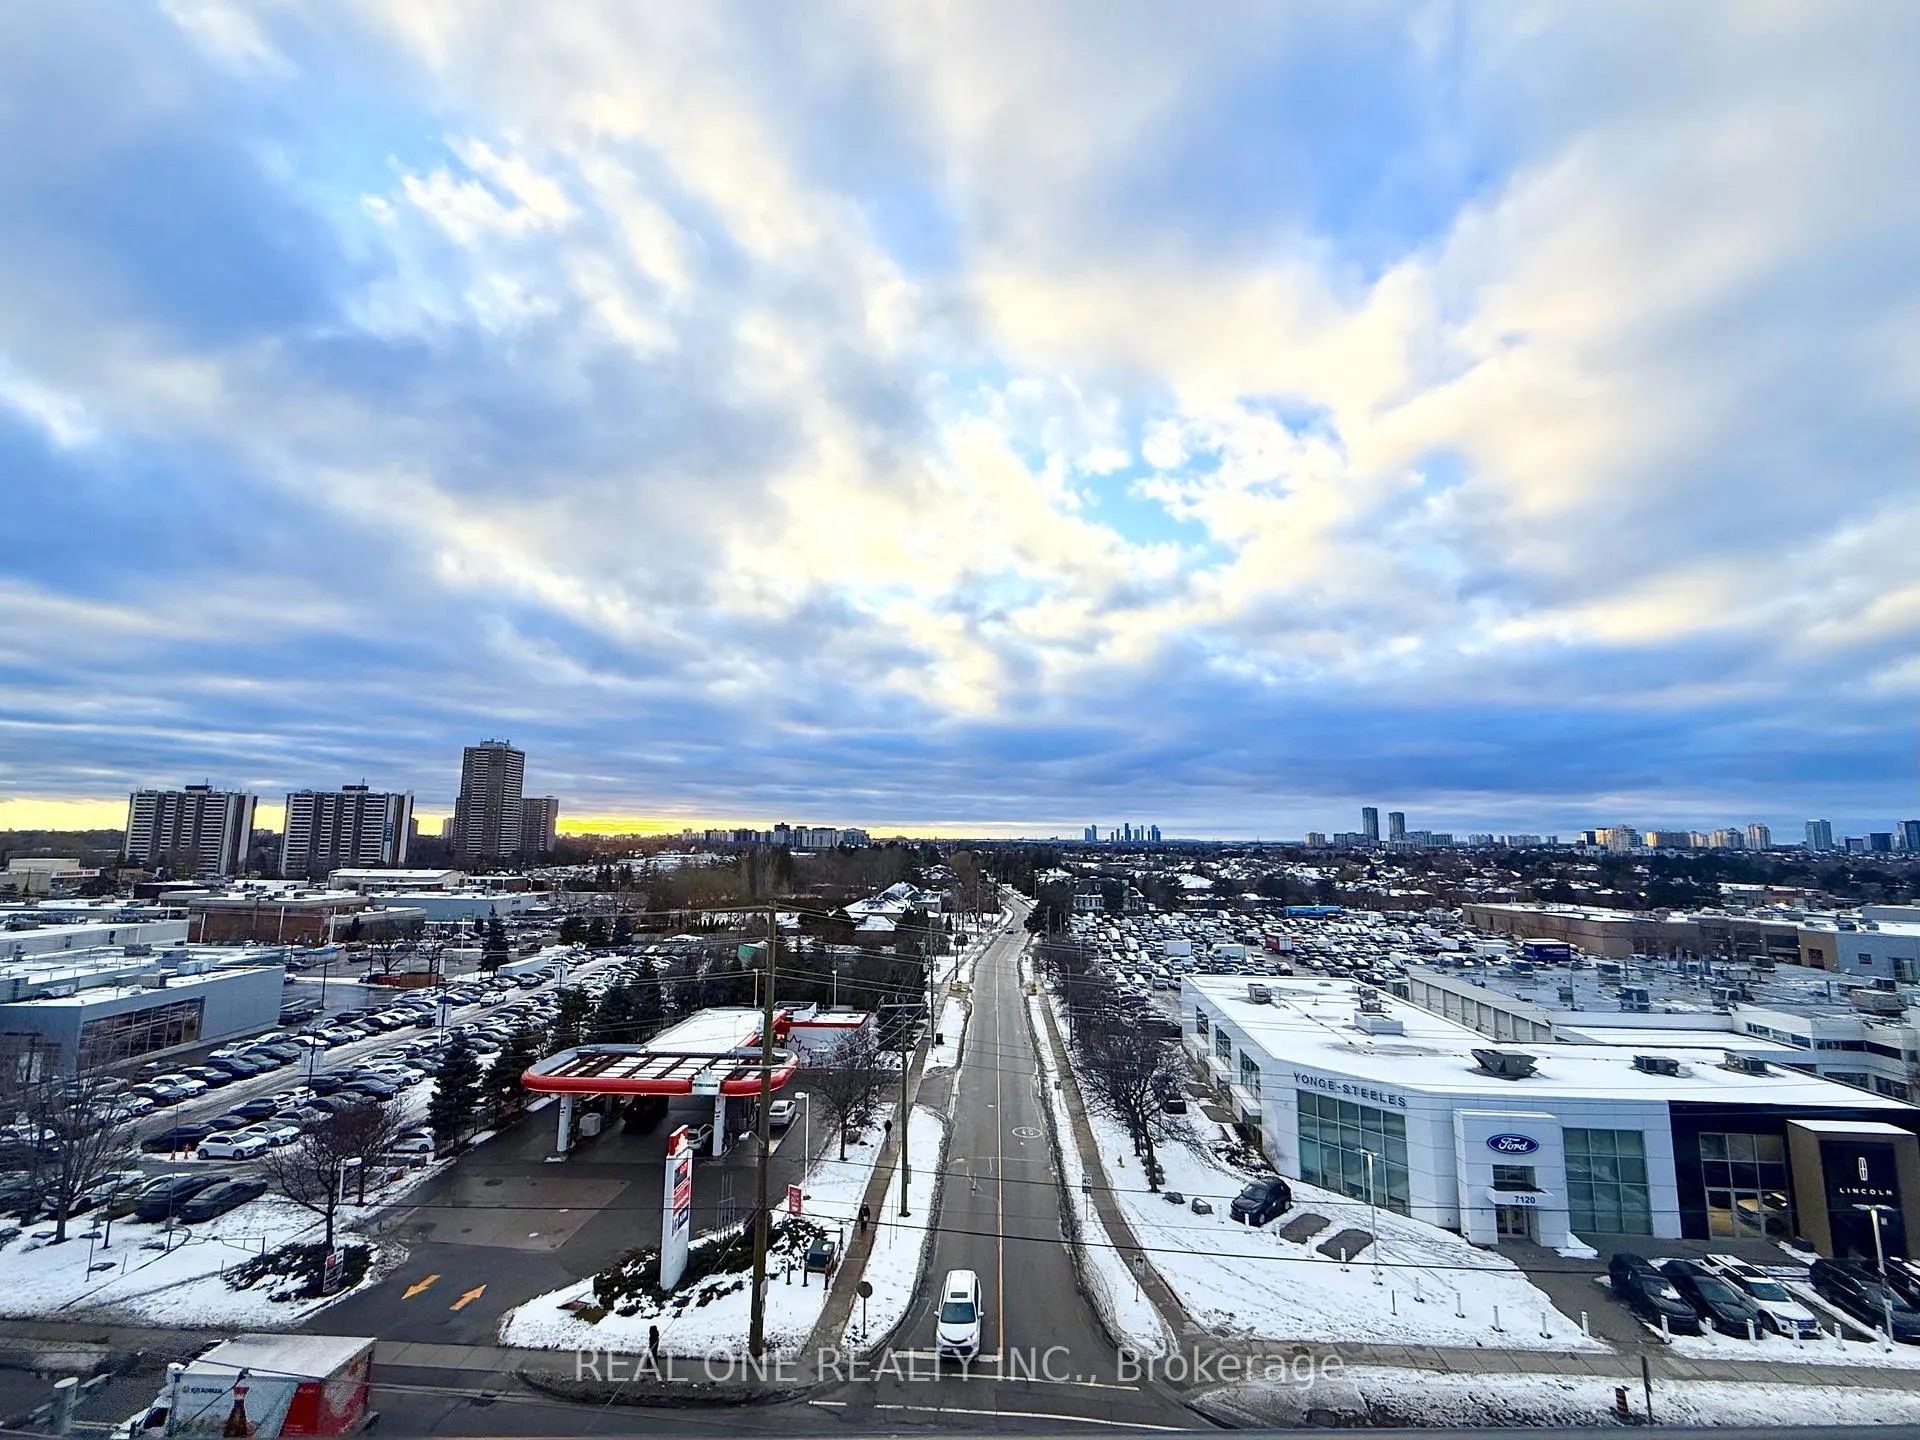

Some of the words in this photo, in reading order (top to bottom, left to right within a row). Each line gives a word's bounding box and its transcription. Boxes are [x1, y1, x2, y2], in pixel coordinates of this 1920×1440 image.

[1293, 1072, 1406, 1107] YONGE-STEELES
[1498, 1137, 1528, 1151] Ford
[1083, 1177, 1092, 1186] 40
[1839, 1187, 1893, 1196] LINCOLN
[1514, 1195, 1536, 1204] 7120
